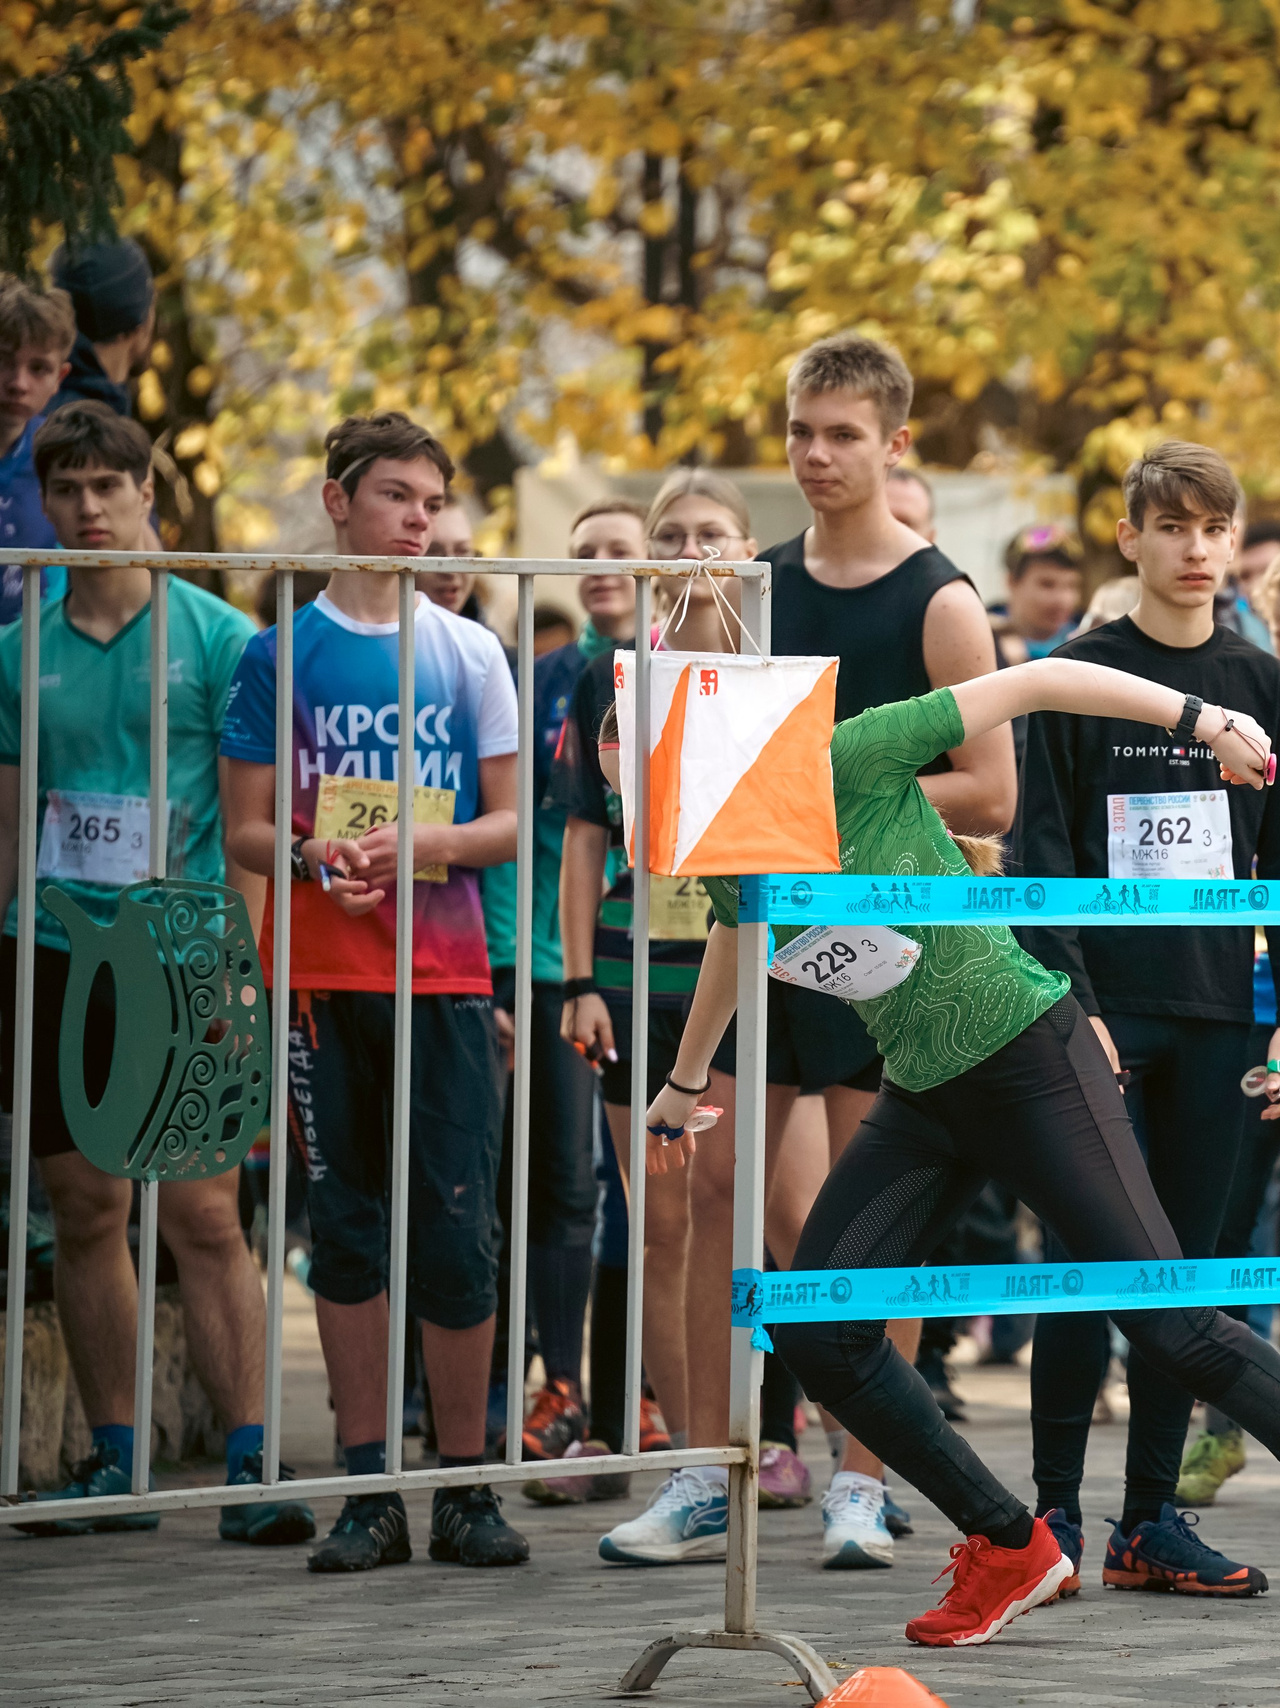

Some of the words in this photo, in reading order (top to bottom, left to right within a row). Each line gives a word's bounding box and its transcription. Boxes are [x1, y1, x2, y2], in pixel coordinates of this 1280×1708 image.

[314, 703, 453, 748] КРОСС
[1112, 746, 1169, 757] TOMMY
[1112, 796, 1125, 823] ЭТАП
[1129, 795, 1167, 805] ПЕРВЕНСТВО
[69, 814, 121, 844] 265
[346, 802, 399, 830] 26
[130, 832, 143, 850] 3
[1138, 816, 1193, 846] 262
[1203, 828, 1213, 847] 3
[1132, 848, 1169, 860] МЖ16
[775, 931, 812, 962] ПЕРВЕНСТВО
[802, 941, 858, 984] 229
[860, 939, 879, 953] 3
[818, 972, 852, 992] МЖ16
